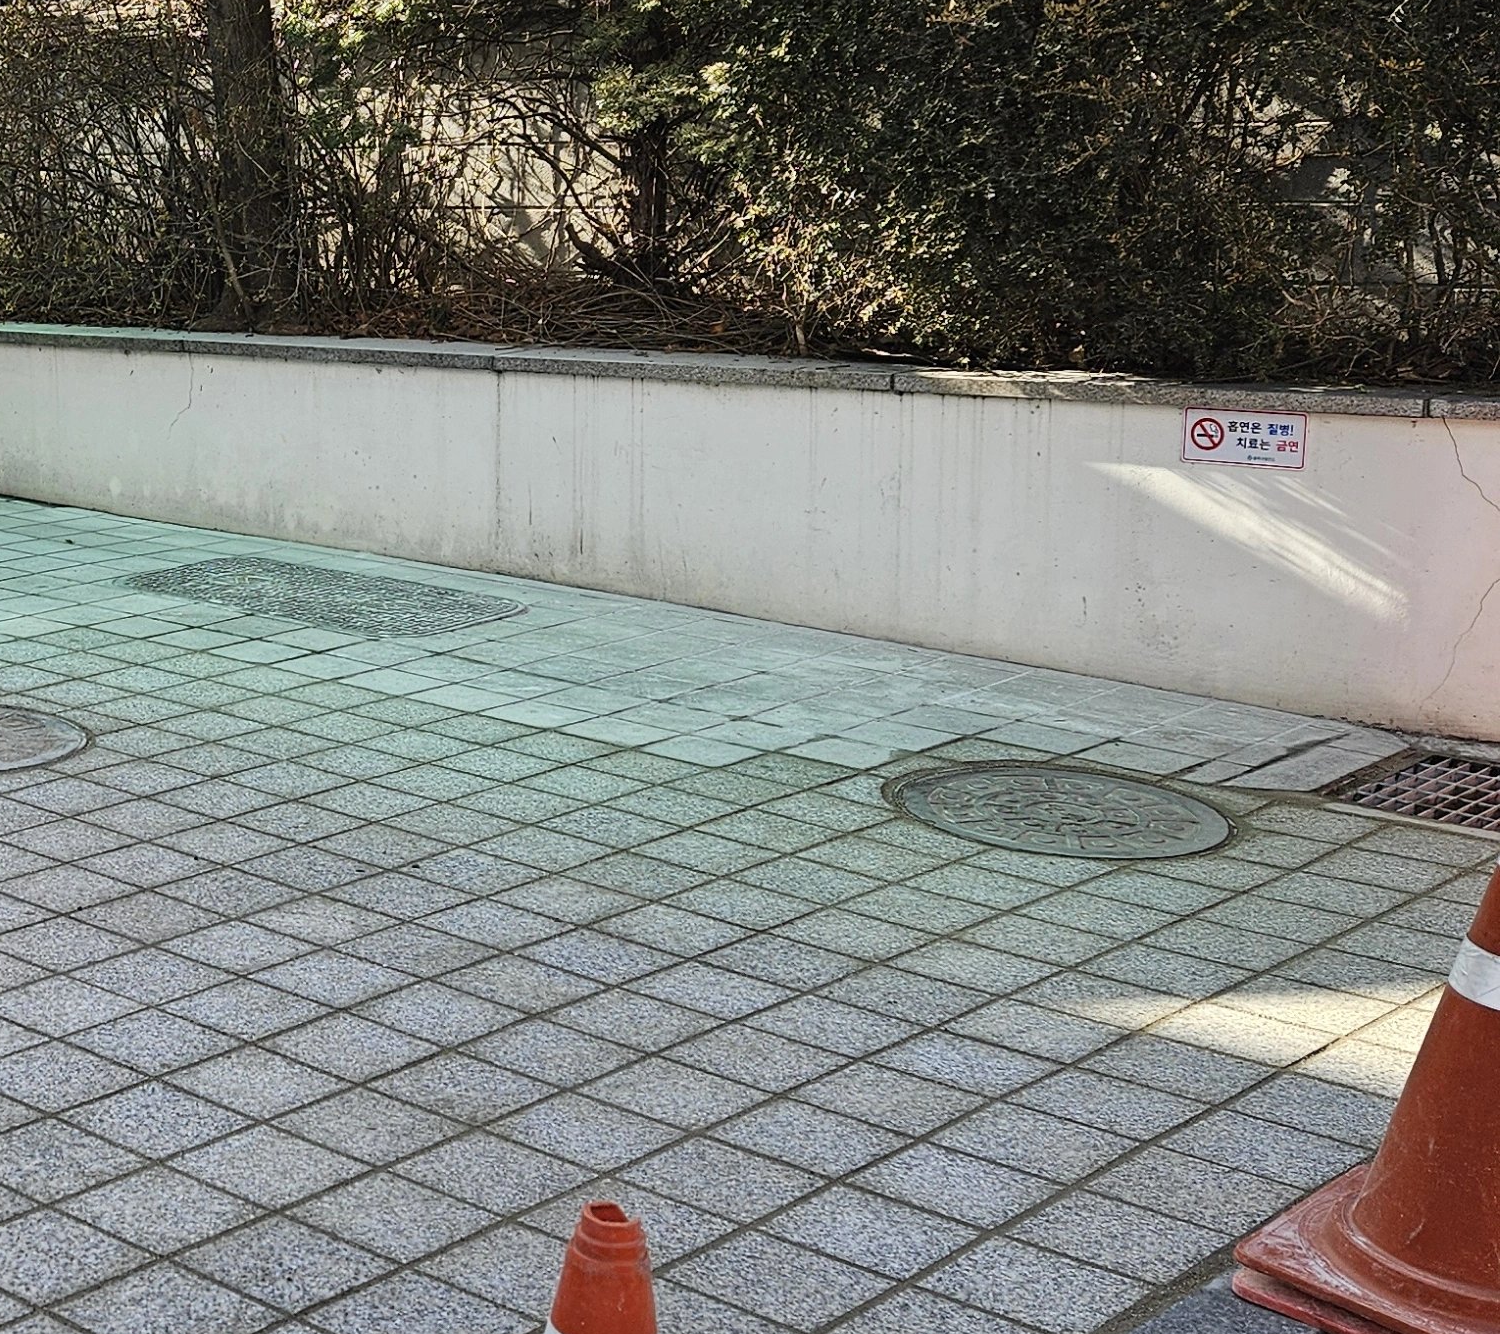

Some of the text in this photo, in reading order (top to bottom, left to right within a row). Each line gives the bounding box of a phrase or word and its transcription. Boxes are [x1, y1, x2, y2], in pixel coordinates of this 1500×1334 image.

[1227, 421, 1294, 437] 흡연은 질병!
[1236, 437, 1299, 453] 치료는 금연
